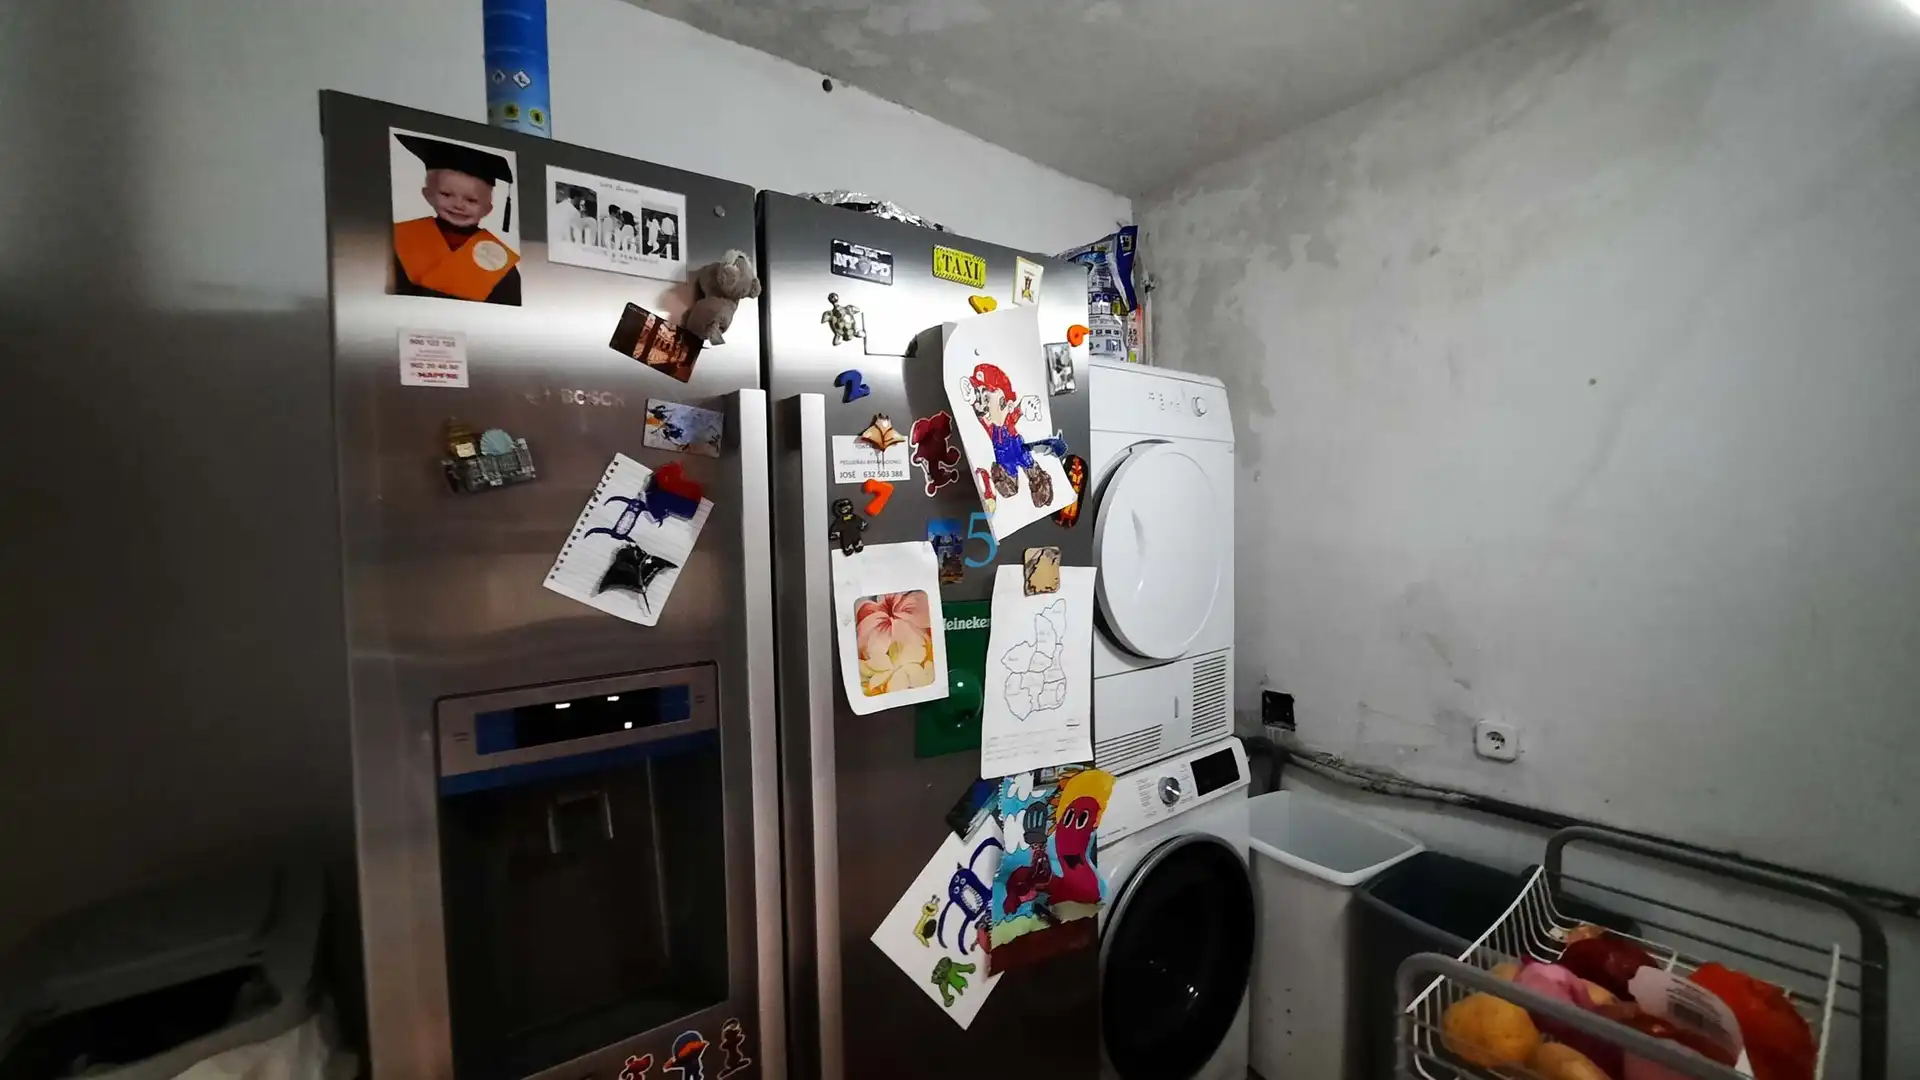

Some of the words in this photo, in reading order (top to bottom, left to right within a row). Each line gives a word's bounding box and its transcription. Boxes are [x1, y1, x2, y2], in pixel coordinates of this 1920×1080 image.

[942, 253, 979, 280] TAXI
[834, 369, 871, 404] 2
[839, 470, 856, 479] JOSÉ
[863, 470, 876, 478] 632
[862, 479, 894, 517] 7
